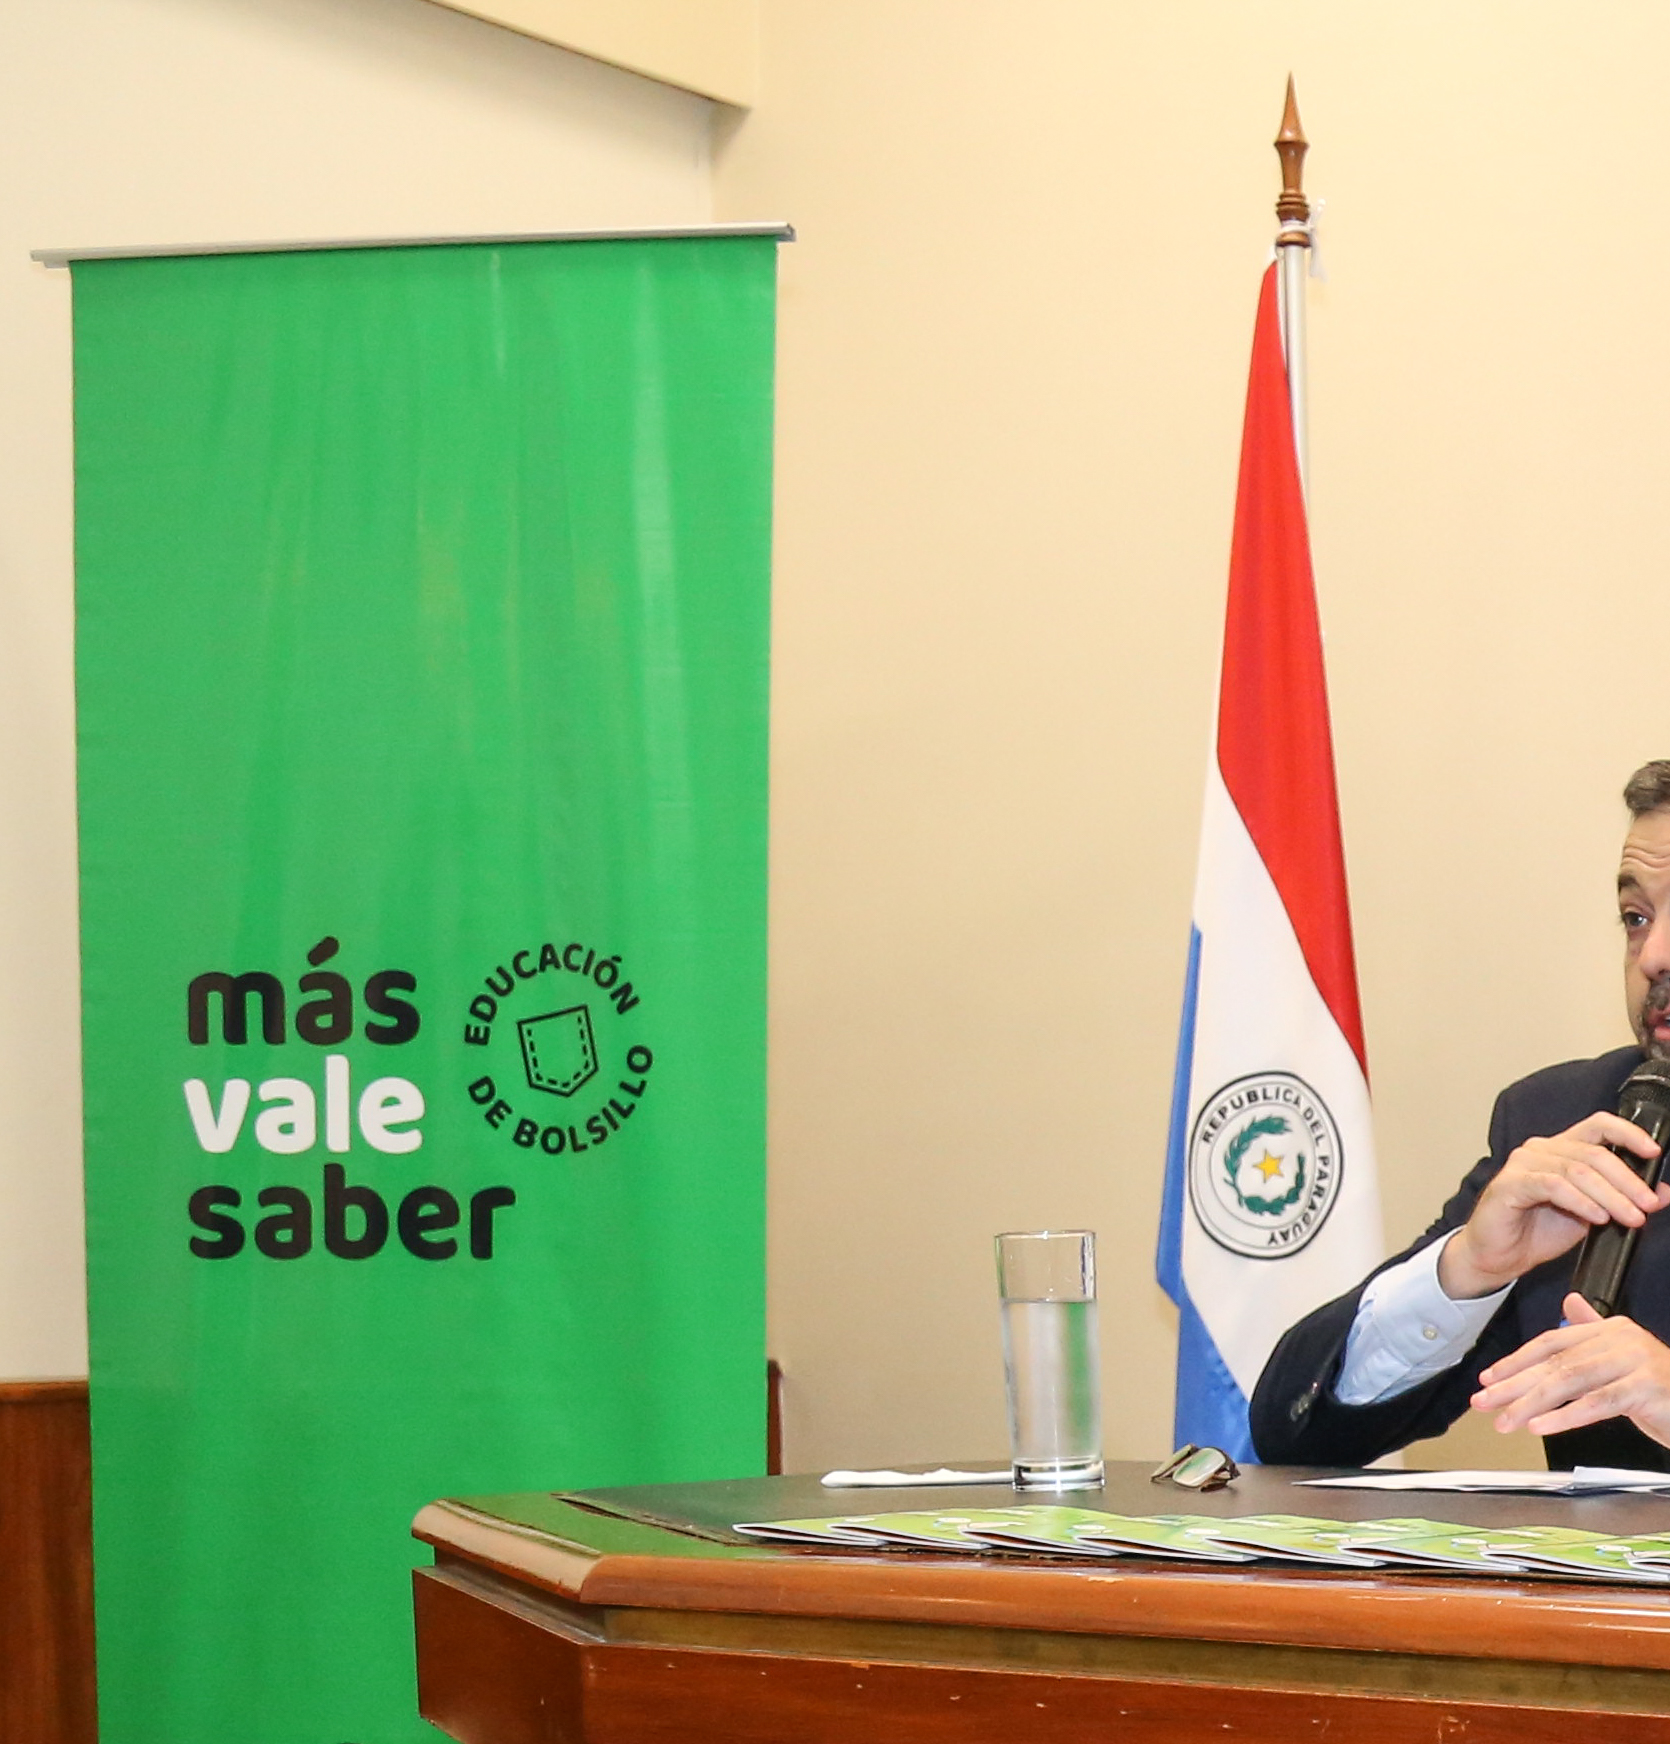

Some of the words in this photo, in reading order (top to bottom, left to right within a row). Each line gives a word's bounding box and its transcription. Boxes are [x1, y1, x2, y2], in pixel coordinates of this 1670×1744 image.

[187, 935, 422, 1046] más
[464, 942, 641, 1047] EDUCACIÓN
[183, 1053, 426, 1154] vale
[467, 1075, 514, 1130] DE
[512, 1044, 655, 1156] BOLSILLO
[1202, 1086, 1302, 1145] REPUBLICA
[1302, 1106, 1327, 1147] DEL
[187, 1162, 517, 1261] saber
[1267, 1154, 1331, 1246] PARAGUAY
